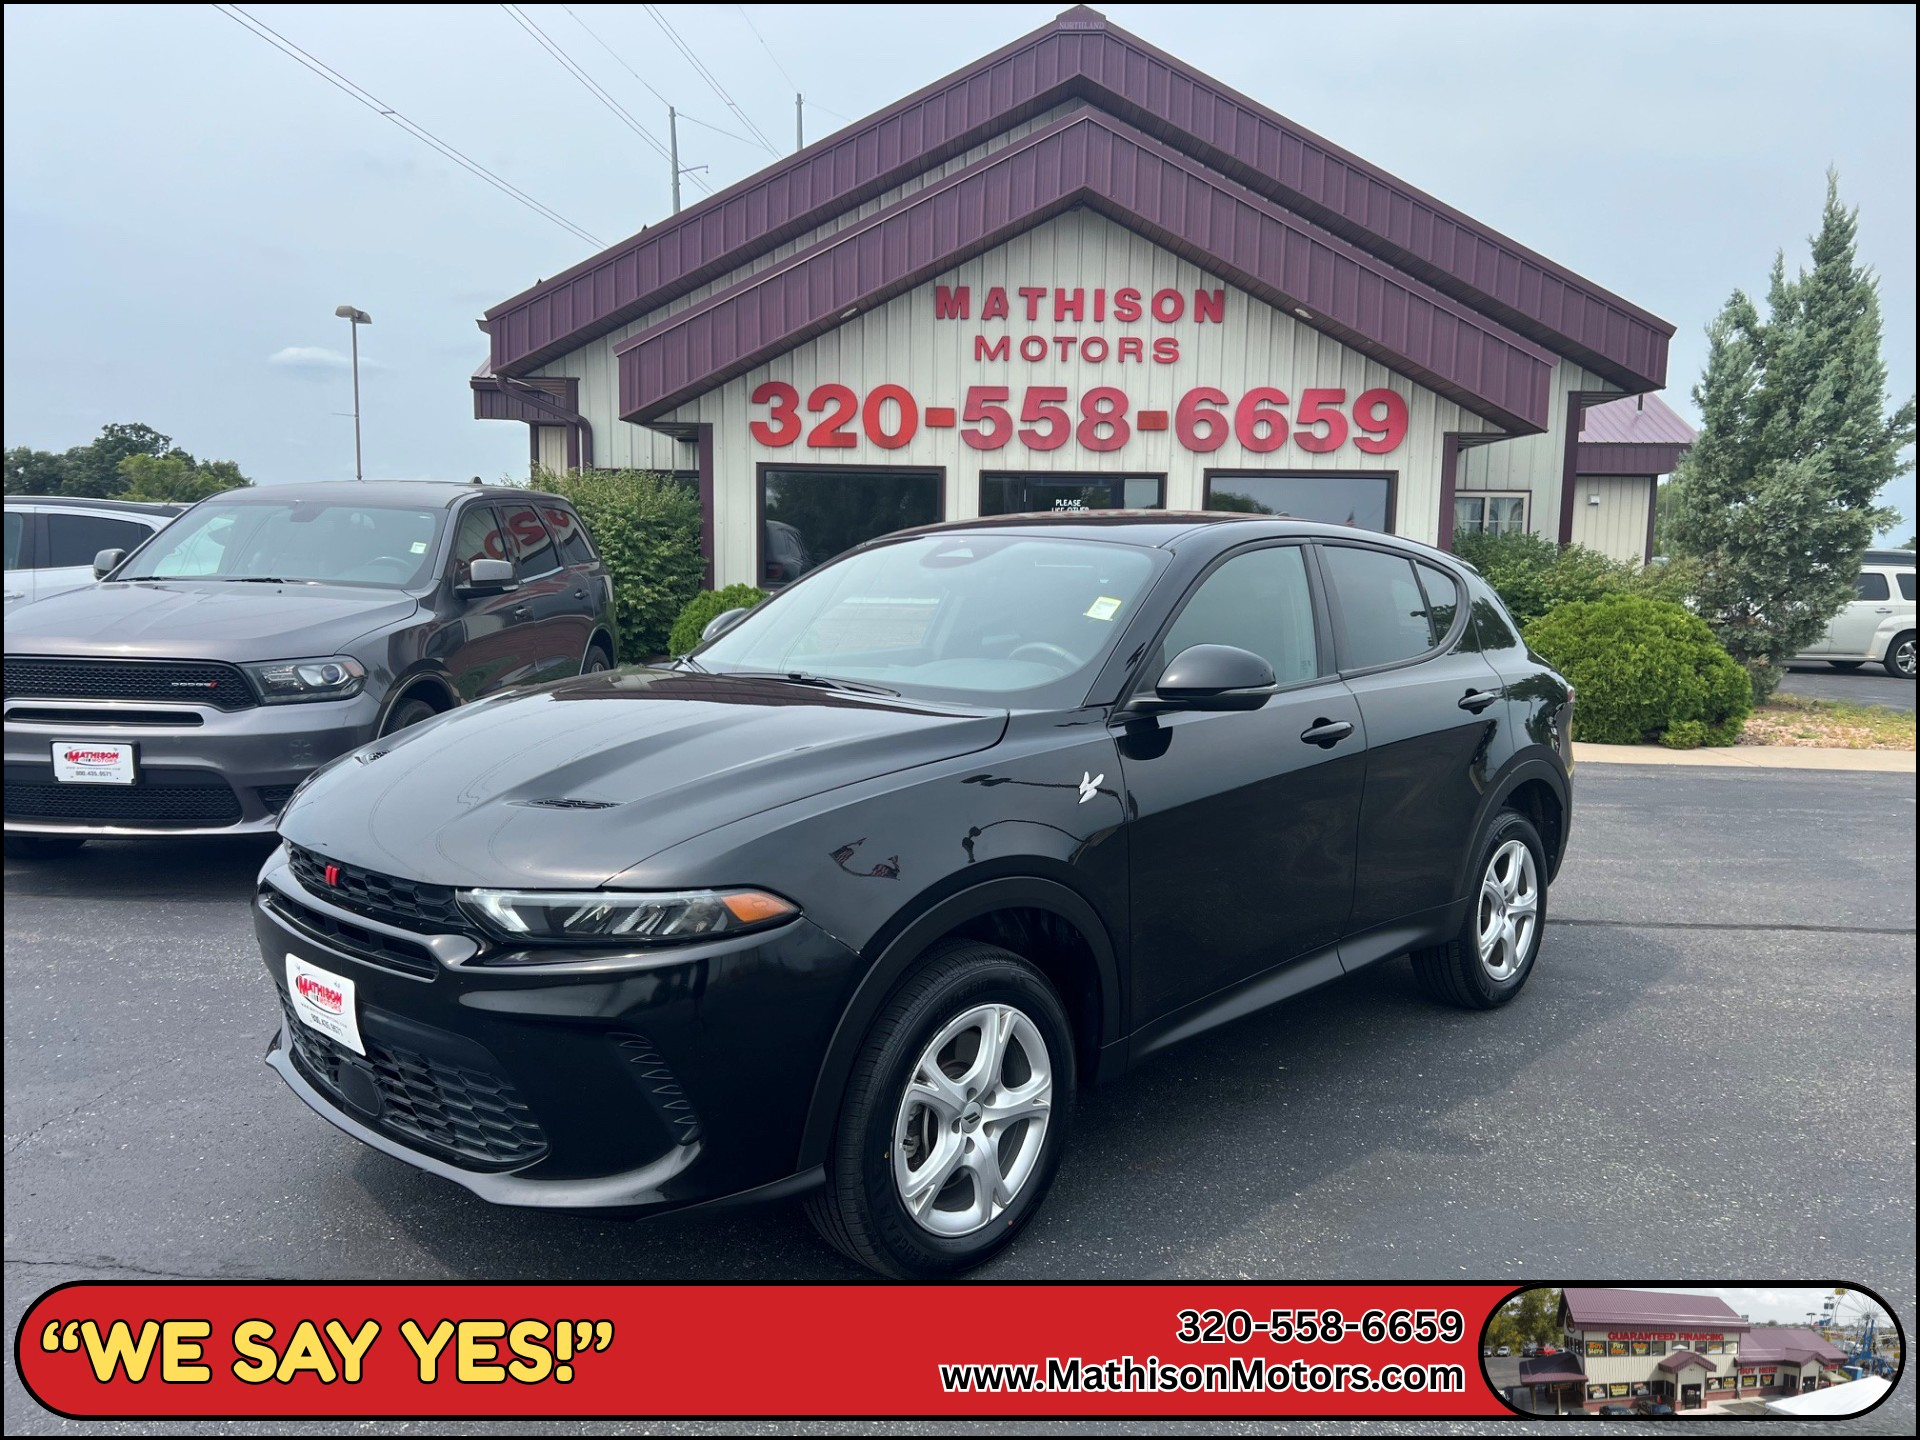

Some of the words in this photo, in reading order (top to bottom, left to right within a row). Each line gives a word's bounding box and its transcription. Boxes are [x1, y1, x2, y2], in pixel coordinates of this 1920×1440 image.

[1059, 21, 1105, 30] NORTHLAND
[935, 285, 1225, 324] MATHISON
[974, 335, 1180, 365] MOTORS
[750, 381, 1409, 454] 320-558-6659
[1055, 499, 1082, 507] PLEASE
[67, 751, 120, 762] MATHISON
[298, 974, 342, 1006] MATHISON
